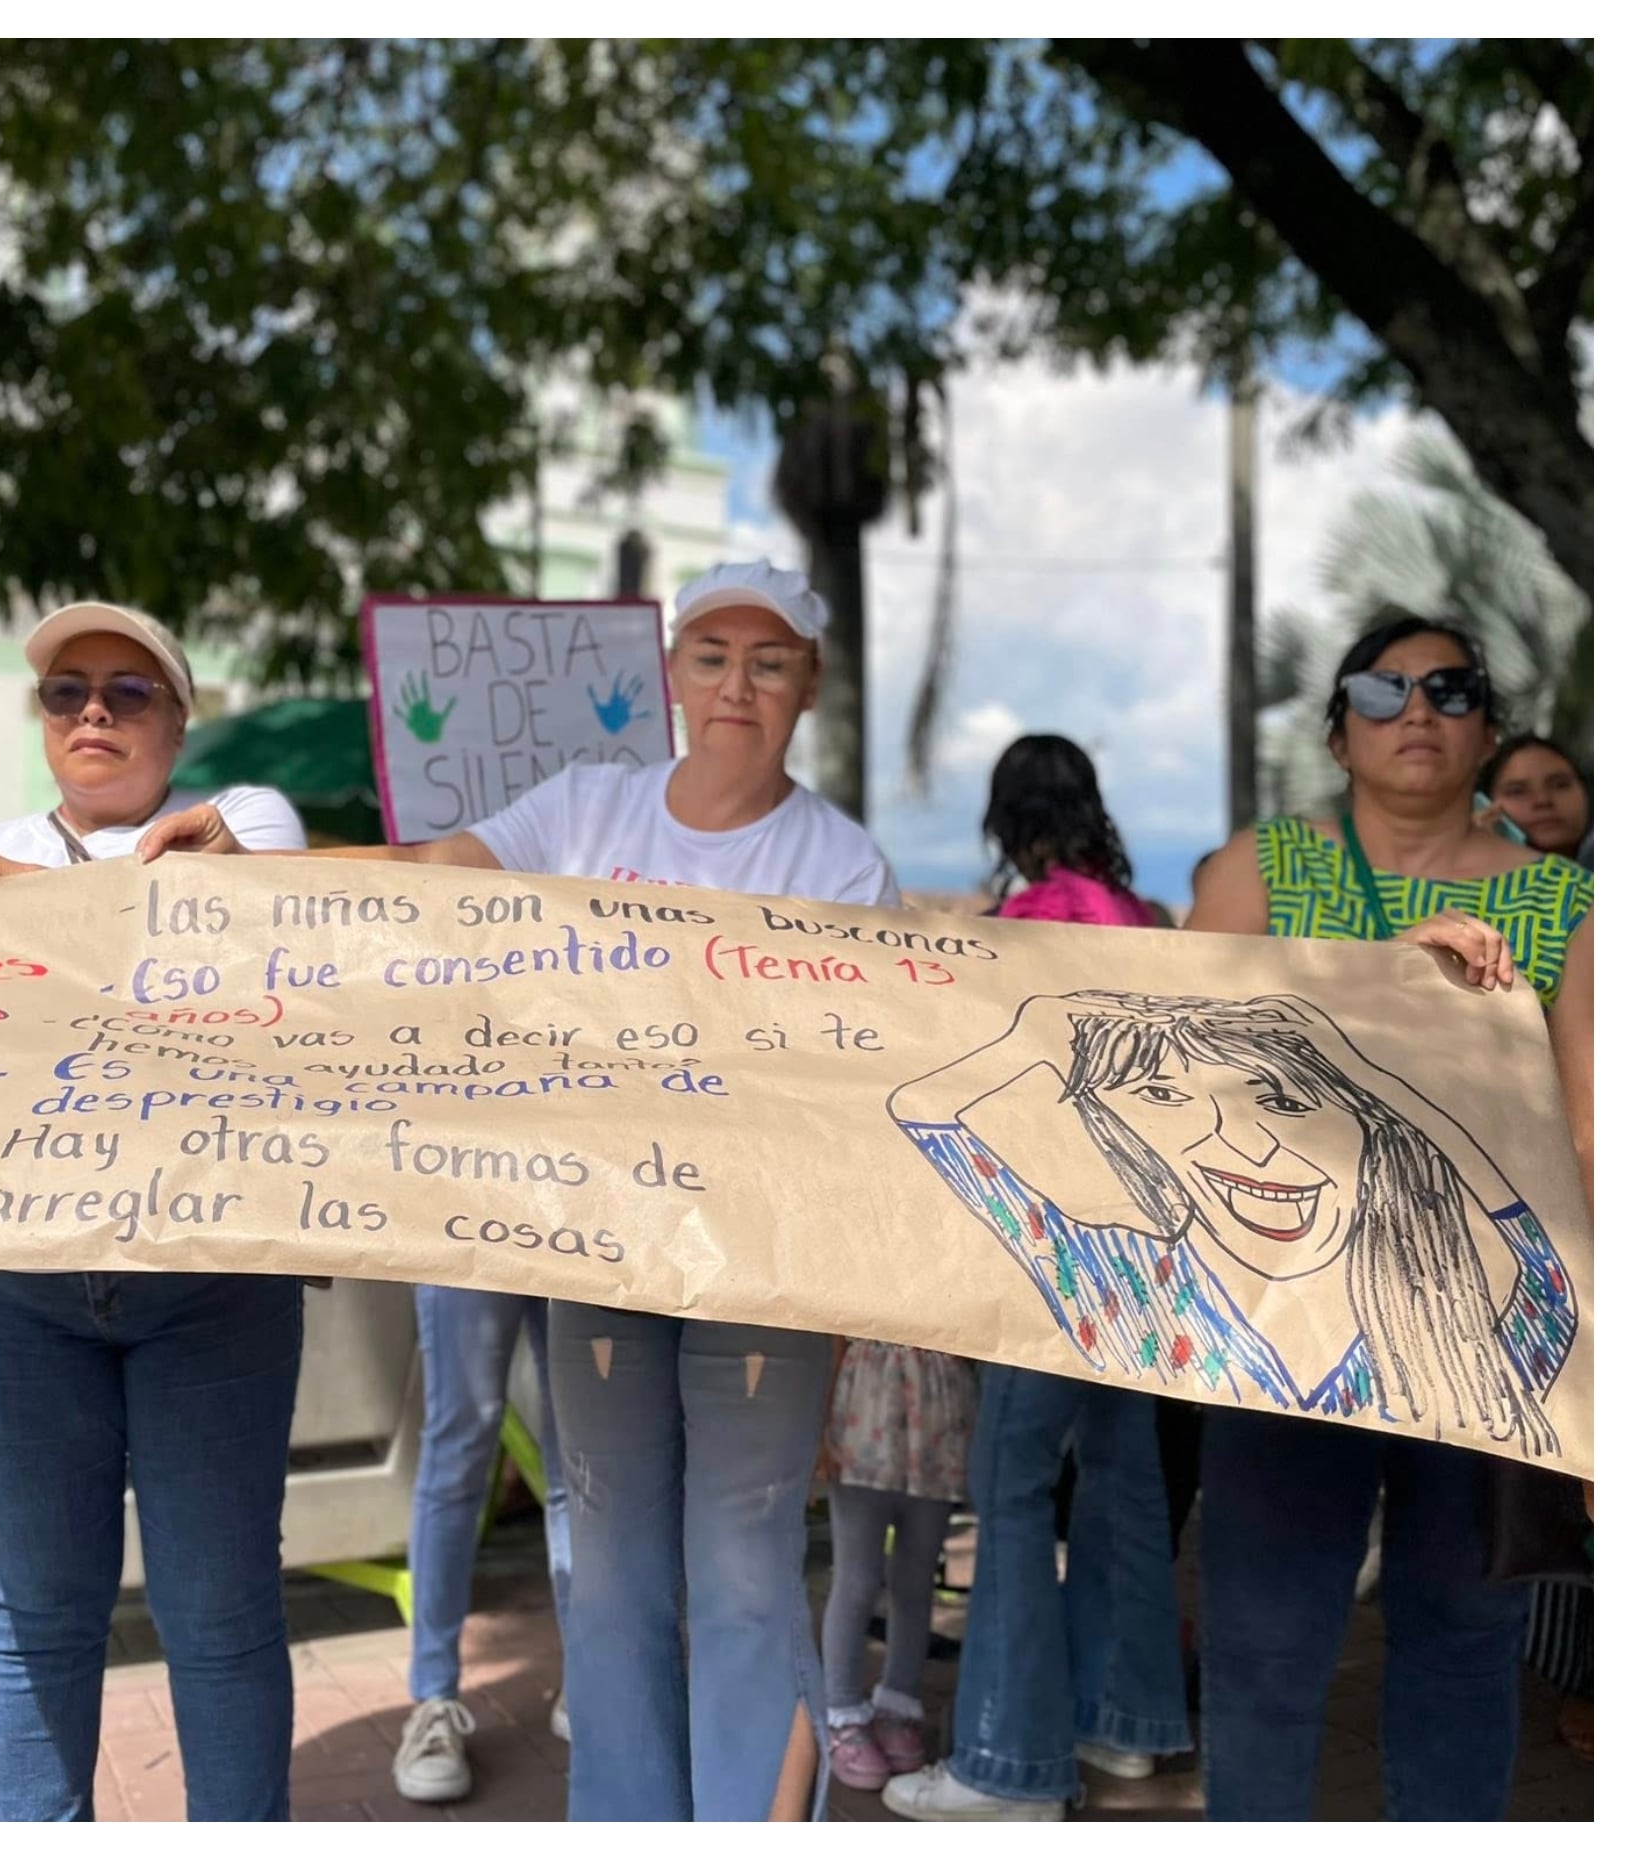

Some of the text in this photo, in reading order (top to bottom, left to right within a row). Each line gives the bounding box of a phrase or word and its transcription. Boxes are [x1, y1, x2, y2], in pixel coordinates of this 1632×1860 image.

[426, 608, 608, 681] BASTA
[487, 679, 555, 749] DE
[264, 946, 343, 992] fue
[383, 923, 671, 989] consentido
[705, 933, 869, 984] (Tenía
[894, 957, 956, 986] 13
[272, 889, 421, 929] niñas
[456, 893, 544, 928] son
[589, 897, 717, 926] unas
[757, 904, 999, 961] busconas
[124, 994, 284, 1028] años)
[272, 1024, 356, 1049] vas
[388, 1022, 422, 1047] a
[464, 1013, 583, 1049] decir
[616, 1020, 699, 1052] eso
[744, 1020, 789, 1052] si
[820, 1011, 885, 1052] te
[53, 1051, 133, 1081] Es
[188, 1066, 303, 1088] una
[344, 1072, 620, 1100] campaña
[660, 1068, 731, 1096] de
[87, 1030, 257, 1069] hemos
[303, 1052, 507, 1080] ayudado
[31, 1085, 398, 1121] desprestigio
[0, 1123, 120, 1172] Hay
[179, 1114, 330, 1168] otras
[384, 1118, 590, 1187] formas
[632, 1140, 707, 1192] de
[299, 1180, 389, 1232] las
[444, 1214, 626, 1263] cosas
